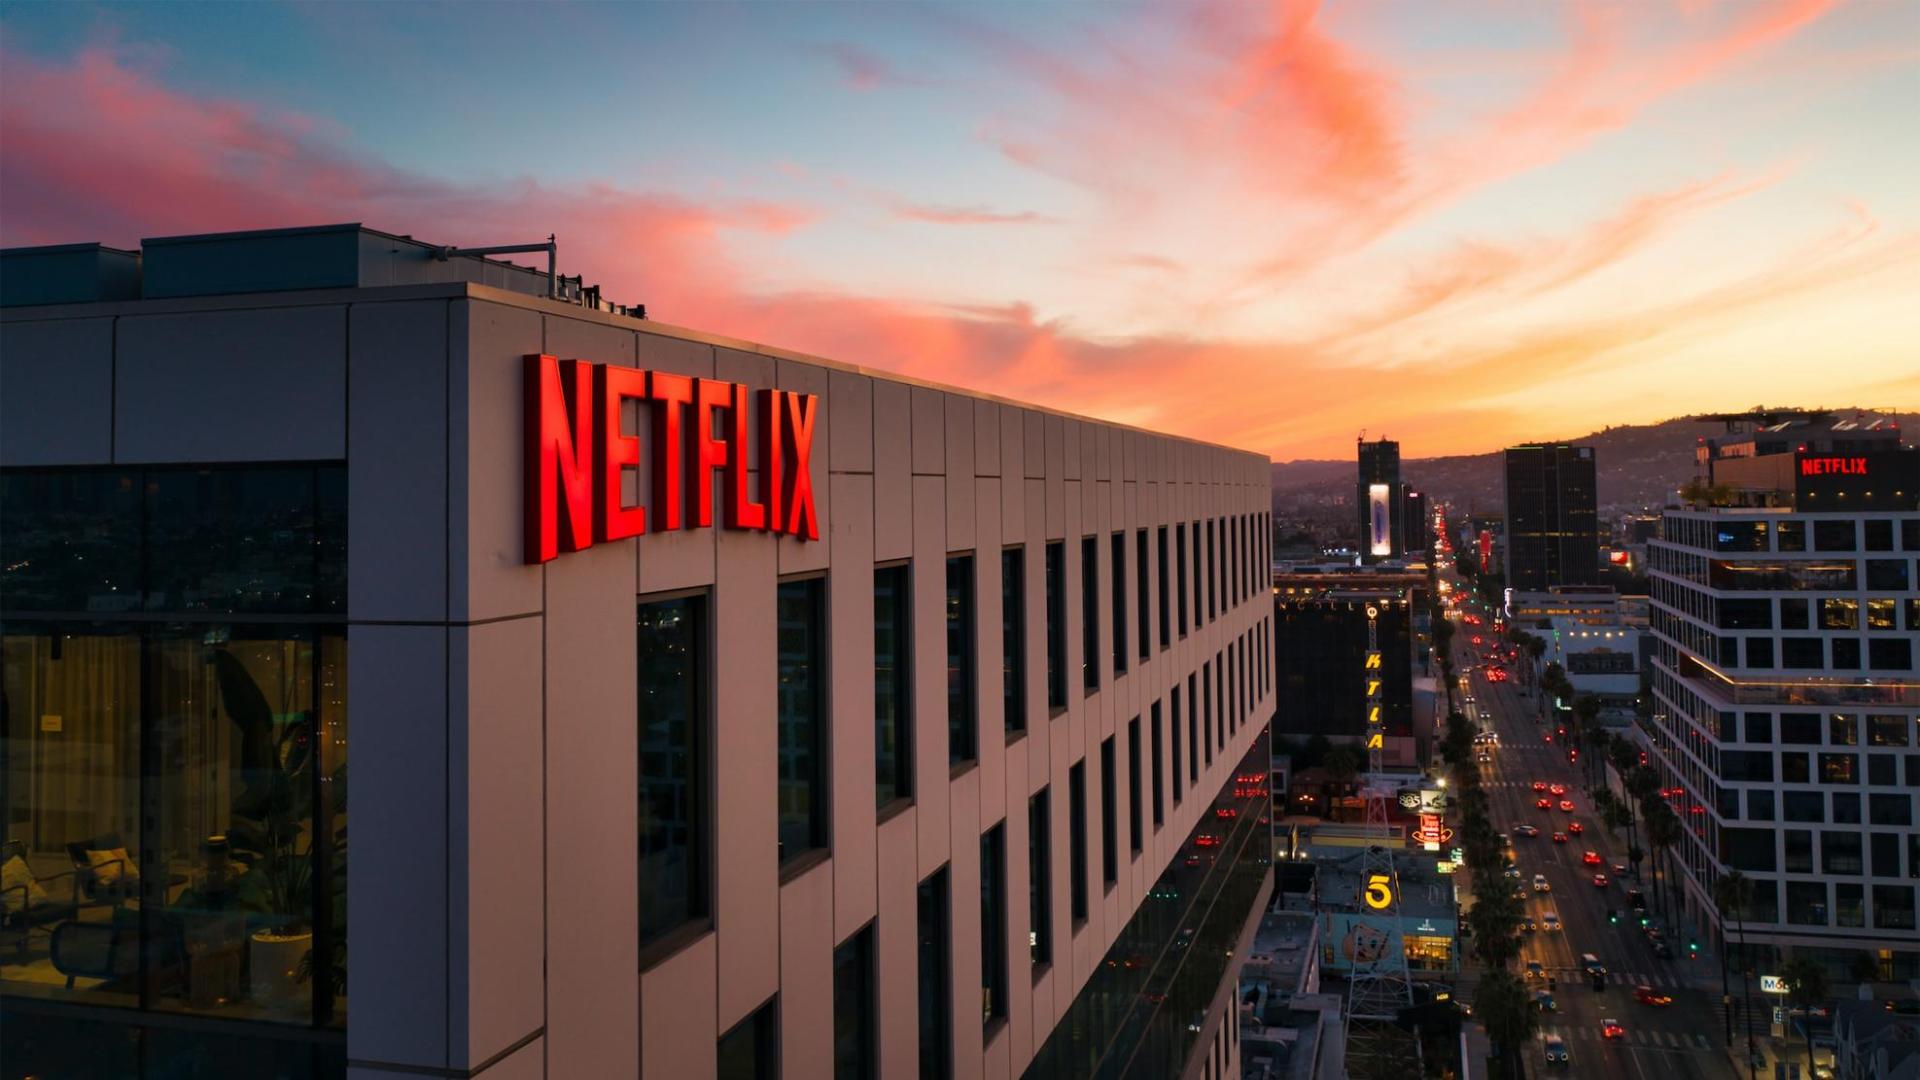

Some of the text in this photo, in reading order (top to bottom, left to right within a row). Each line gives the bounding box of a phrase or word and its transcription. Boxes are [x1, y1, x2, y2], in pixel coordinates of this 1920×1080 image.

[523, 354, 819, 564] NETFLIX
[1801, 458, 1867, 476] NETFLIX
[1365, 653, 1383, 749] KTLA
[1365, 875, 1392, 909] 5
